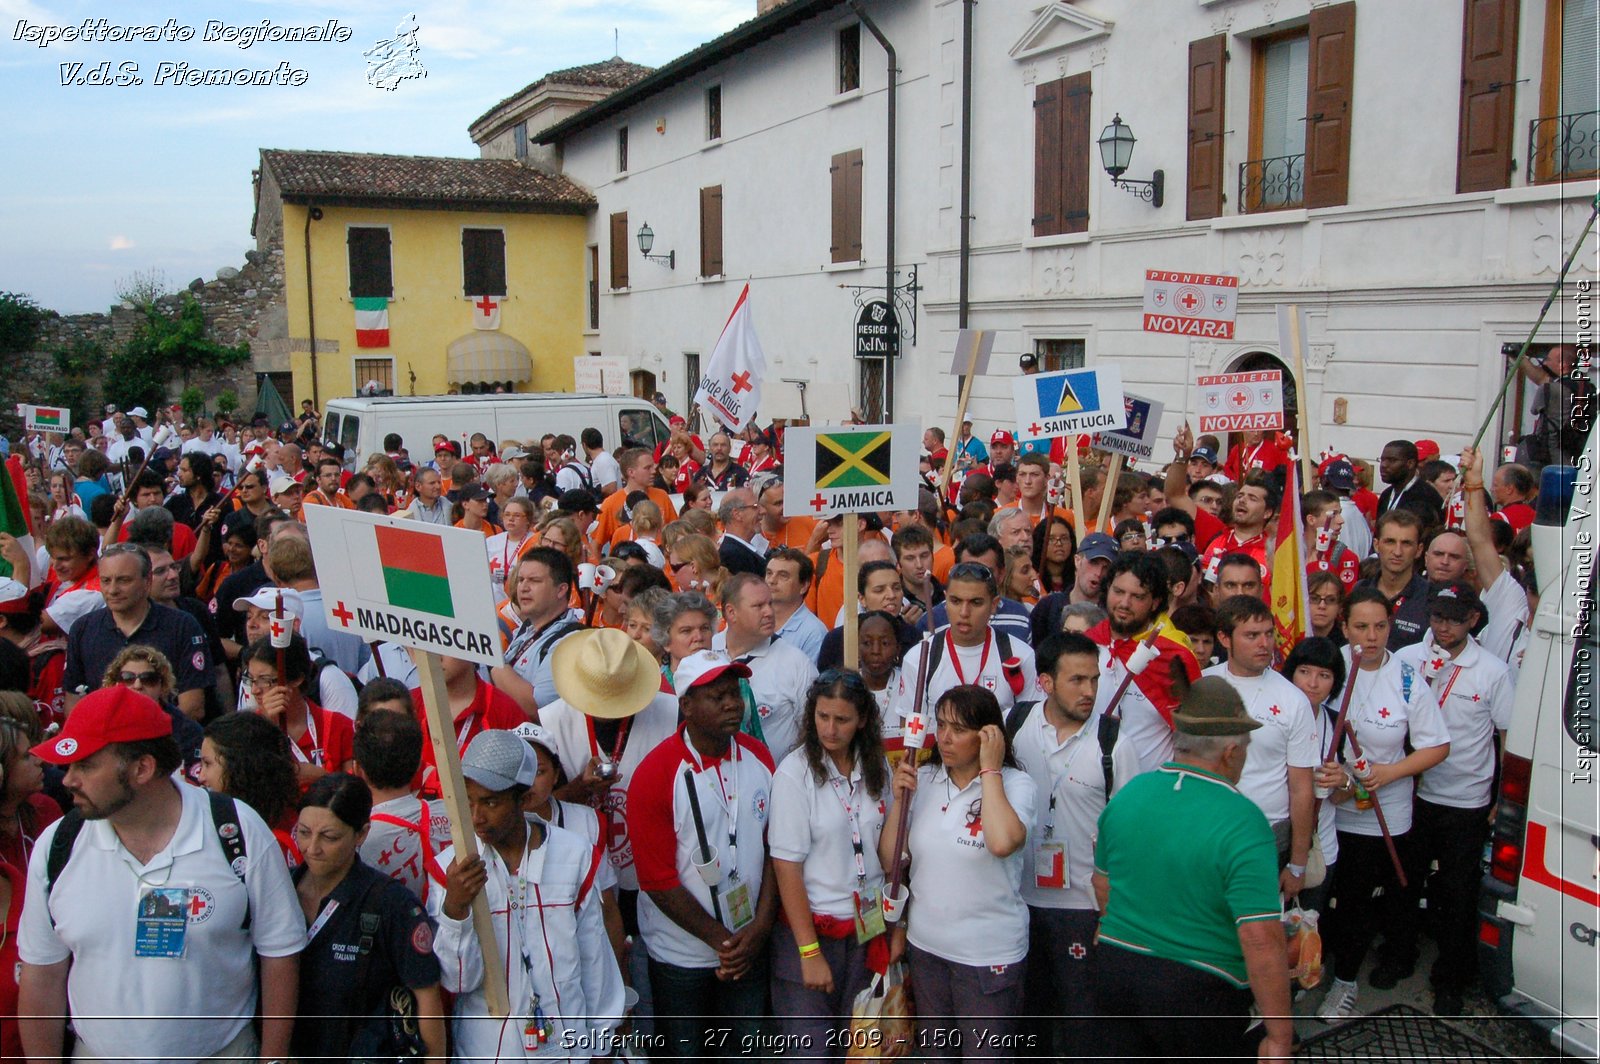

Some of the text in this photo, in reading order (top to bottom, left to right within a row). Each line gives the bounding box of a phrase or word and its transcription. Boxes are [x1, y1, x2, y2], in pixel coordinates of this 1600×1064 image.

[1151, 272, 1233, 286] PIONIERI
[858, 325, 898, 334] RESIDEA
[1147, 316, 1229, 337] NOVARA
[1202, 373, 1276, 385] PIONIERI
[719, 388, 742, 416] Kruis
[1044, 414, 1116, 434] SAINT LUCIA
[1204, 414, 1278, 431] NOVARA
[1101, 435, 1153, 457] CAYMAN ISLANDS
[830, 490, 895, 509] JAMAICA
[356, 607, 495, 657] MADAGASCAR
[347, 945, 360, 953] ROSS
